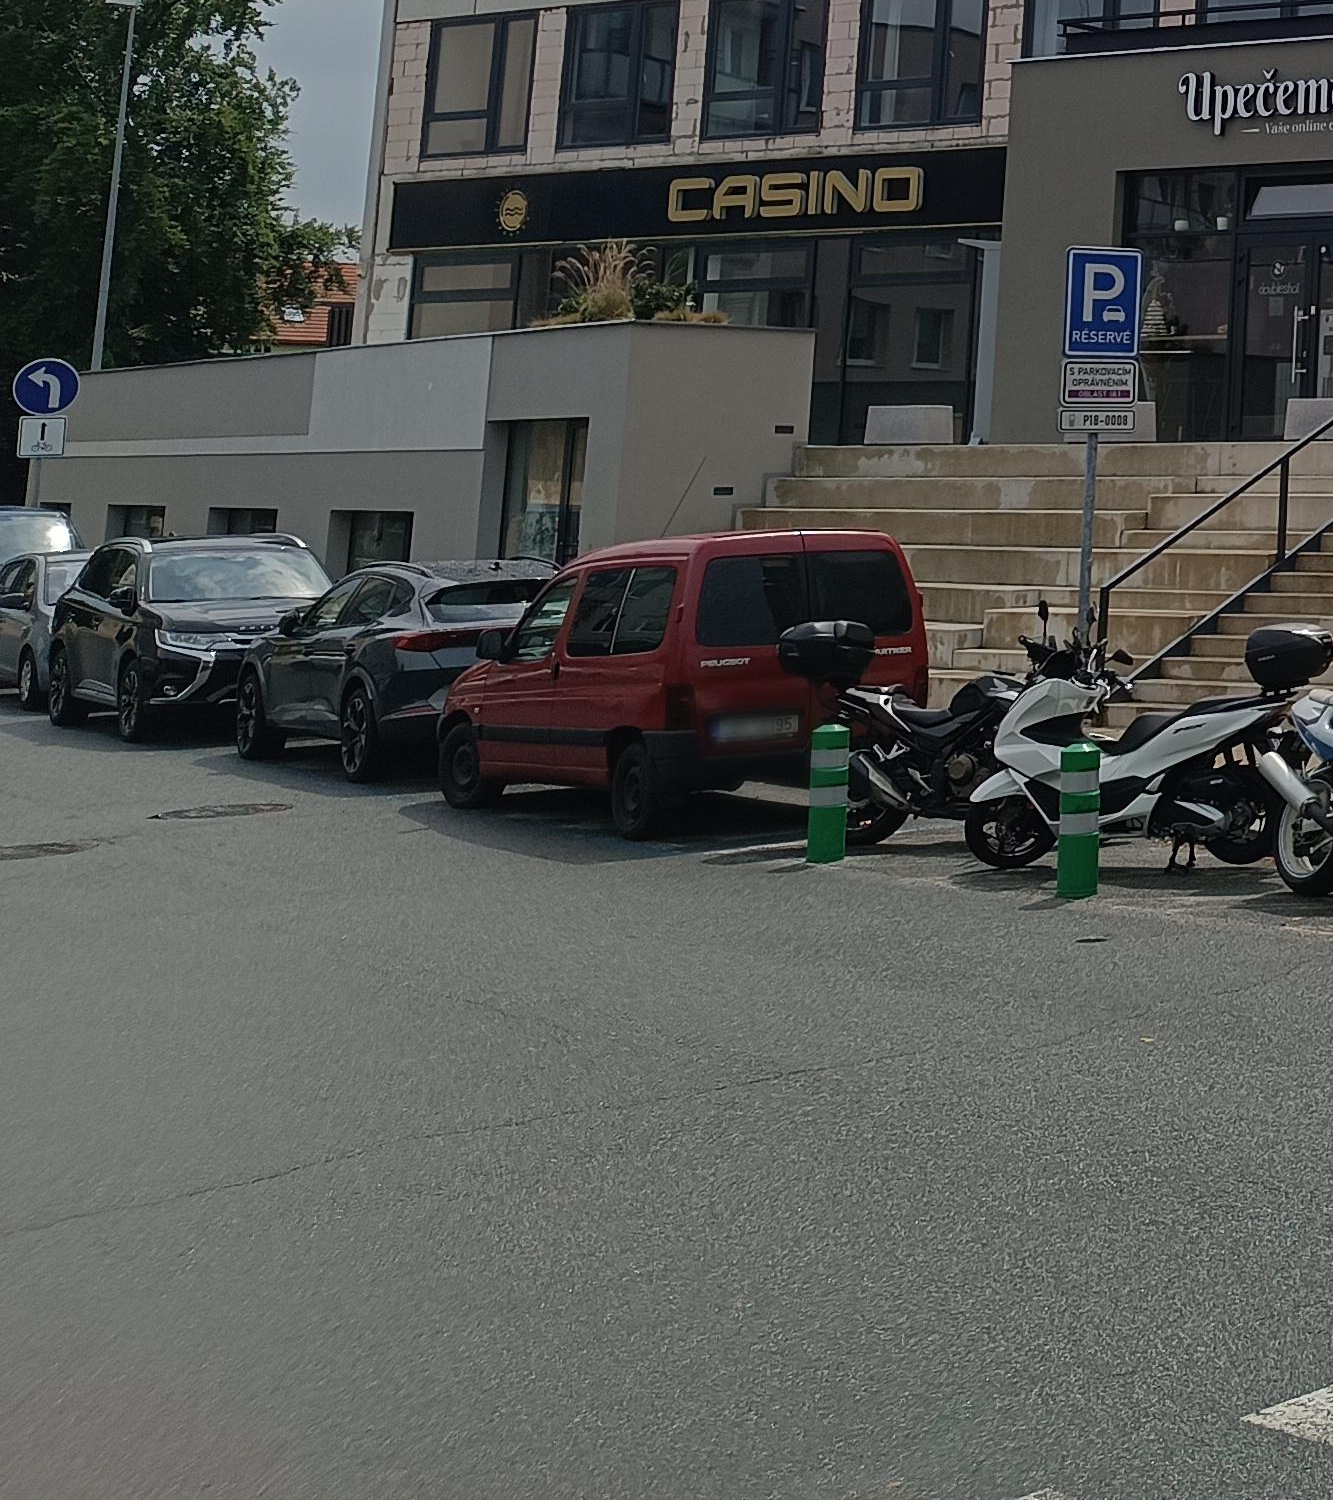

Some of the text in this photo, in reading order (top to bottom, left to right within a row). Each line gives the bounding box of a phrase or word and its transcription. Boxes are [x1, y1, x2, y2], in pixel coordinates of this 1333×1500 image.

[1265, 121, 1290, 135] Vaše
[1291, 119, 1327, 133] online
[668, 166, 925, 222] CASINO
[1083, 263, 1125, 322] P
[1072, 328, 1131, 343] RÉSERVÉ
[1069, 366, 1132, 376] S PARKOVACÍM
[1083, 414, 1128, 426] P18-0008
[875, 646, 912, 655] ARTNER
[700, 657, 751, 668] PEUGEOT
